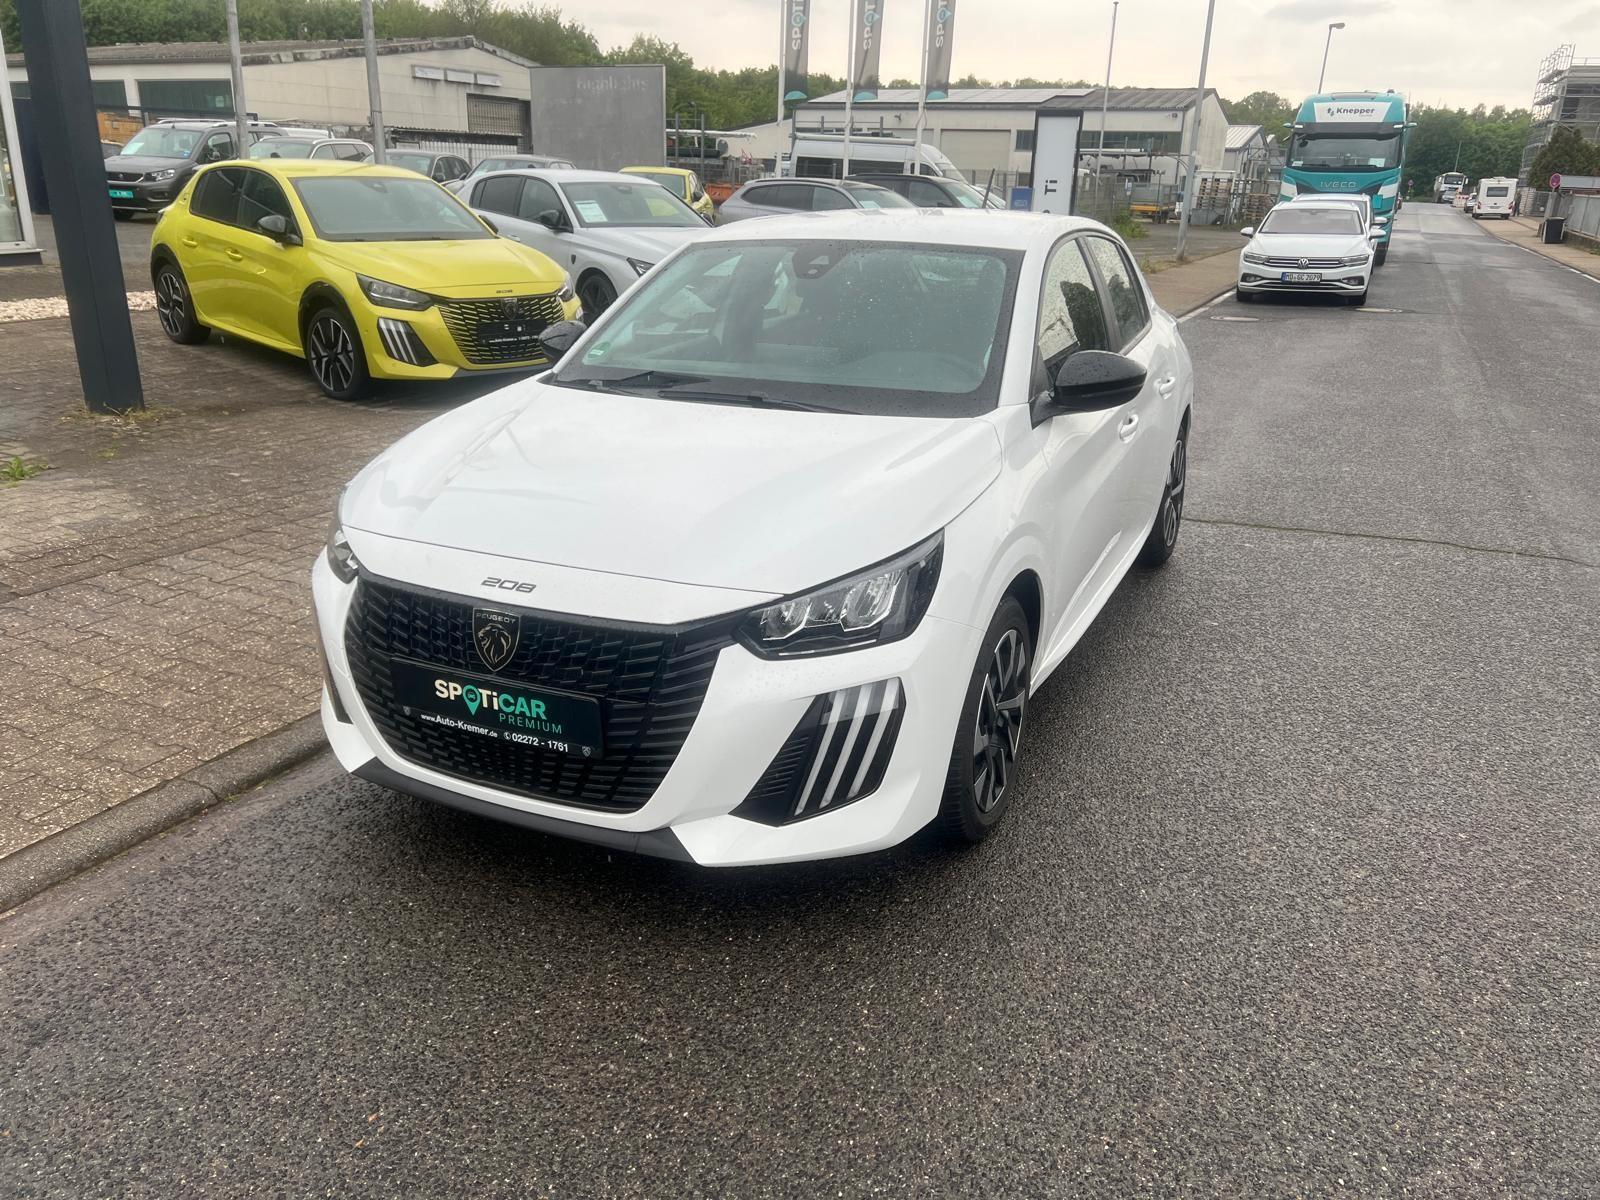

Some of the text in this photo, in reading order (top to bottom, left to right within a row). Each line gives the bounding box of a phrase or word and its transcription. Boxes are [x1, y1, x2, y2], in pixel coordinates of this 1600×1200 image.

[1336, 107, 1375, 116] Knepper
[481, 576, 537, 593] 208
[476, 612, 516, 624] PEUGEOT
[499, 713, 562, 734] PREMIUM
[420, 714, 498, 738] www.Auto-Kremer.de
[512, 733, 539, 746] 02272
[548, 740, 569, 752] 1761
